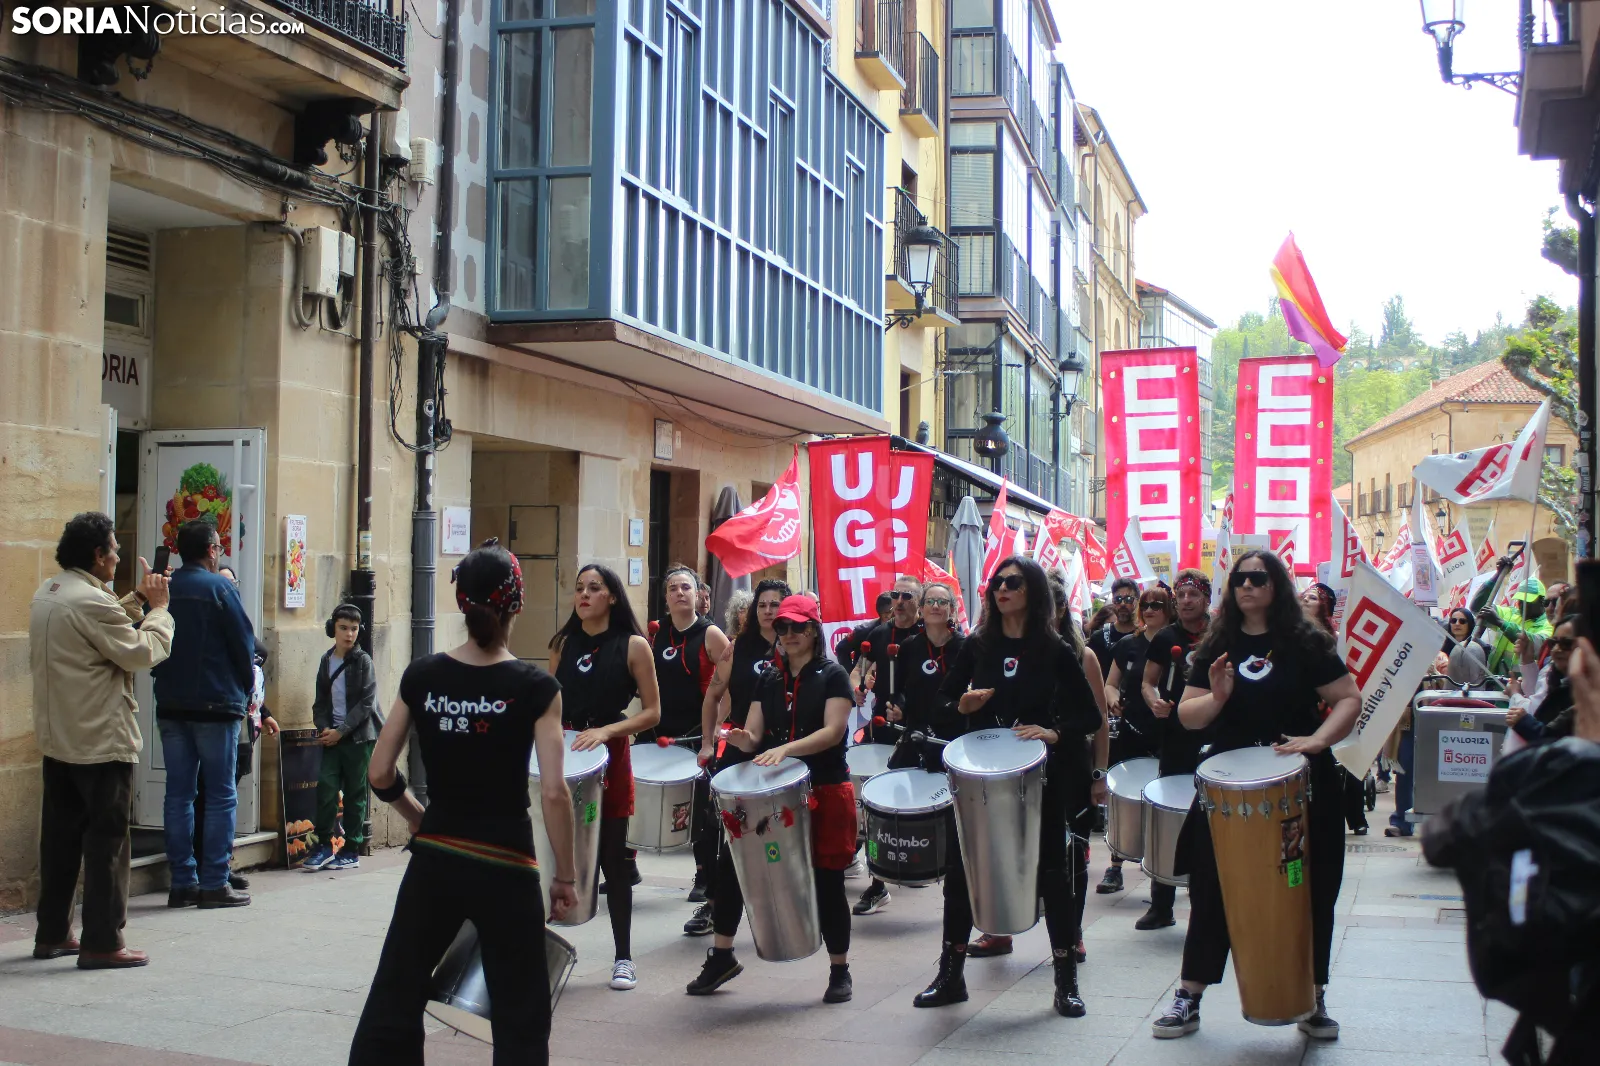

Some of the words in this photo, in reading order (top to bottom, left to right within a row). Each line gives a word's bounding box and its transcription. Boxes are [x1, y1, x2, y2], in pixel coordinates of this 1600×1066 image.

[831, 452, 876, 615] UGT
[1385, 642, 1413, 677] León
[1381, 676, 1392, 689] y
[424, 692, 507, 714] kilombo
[1450, 736, 1490, 745] VALORIZA
[1455, 752, 1487, 765] Soria
[877, 828, 930, 849] kilombo
